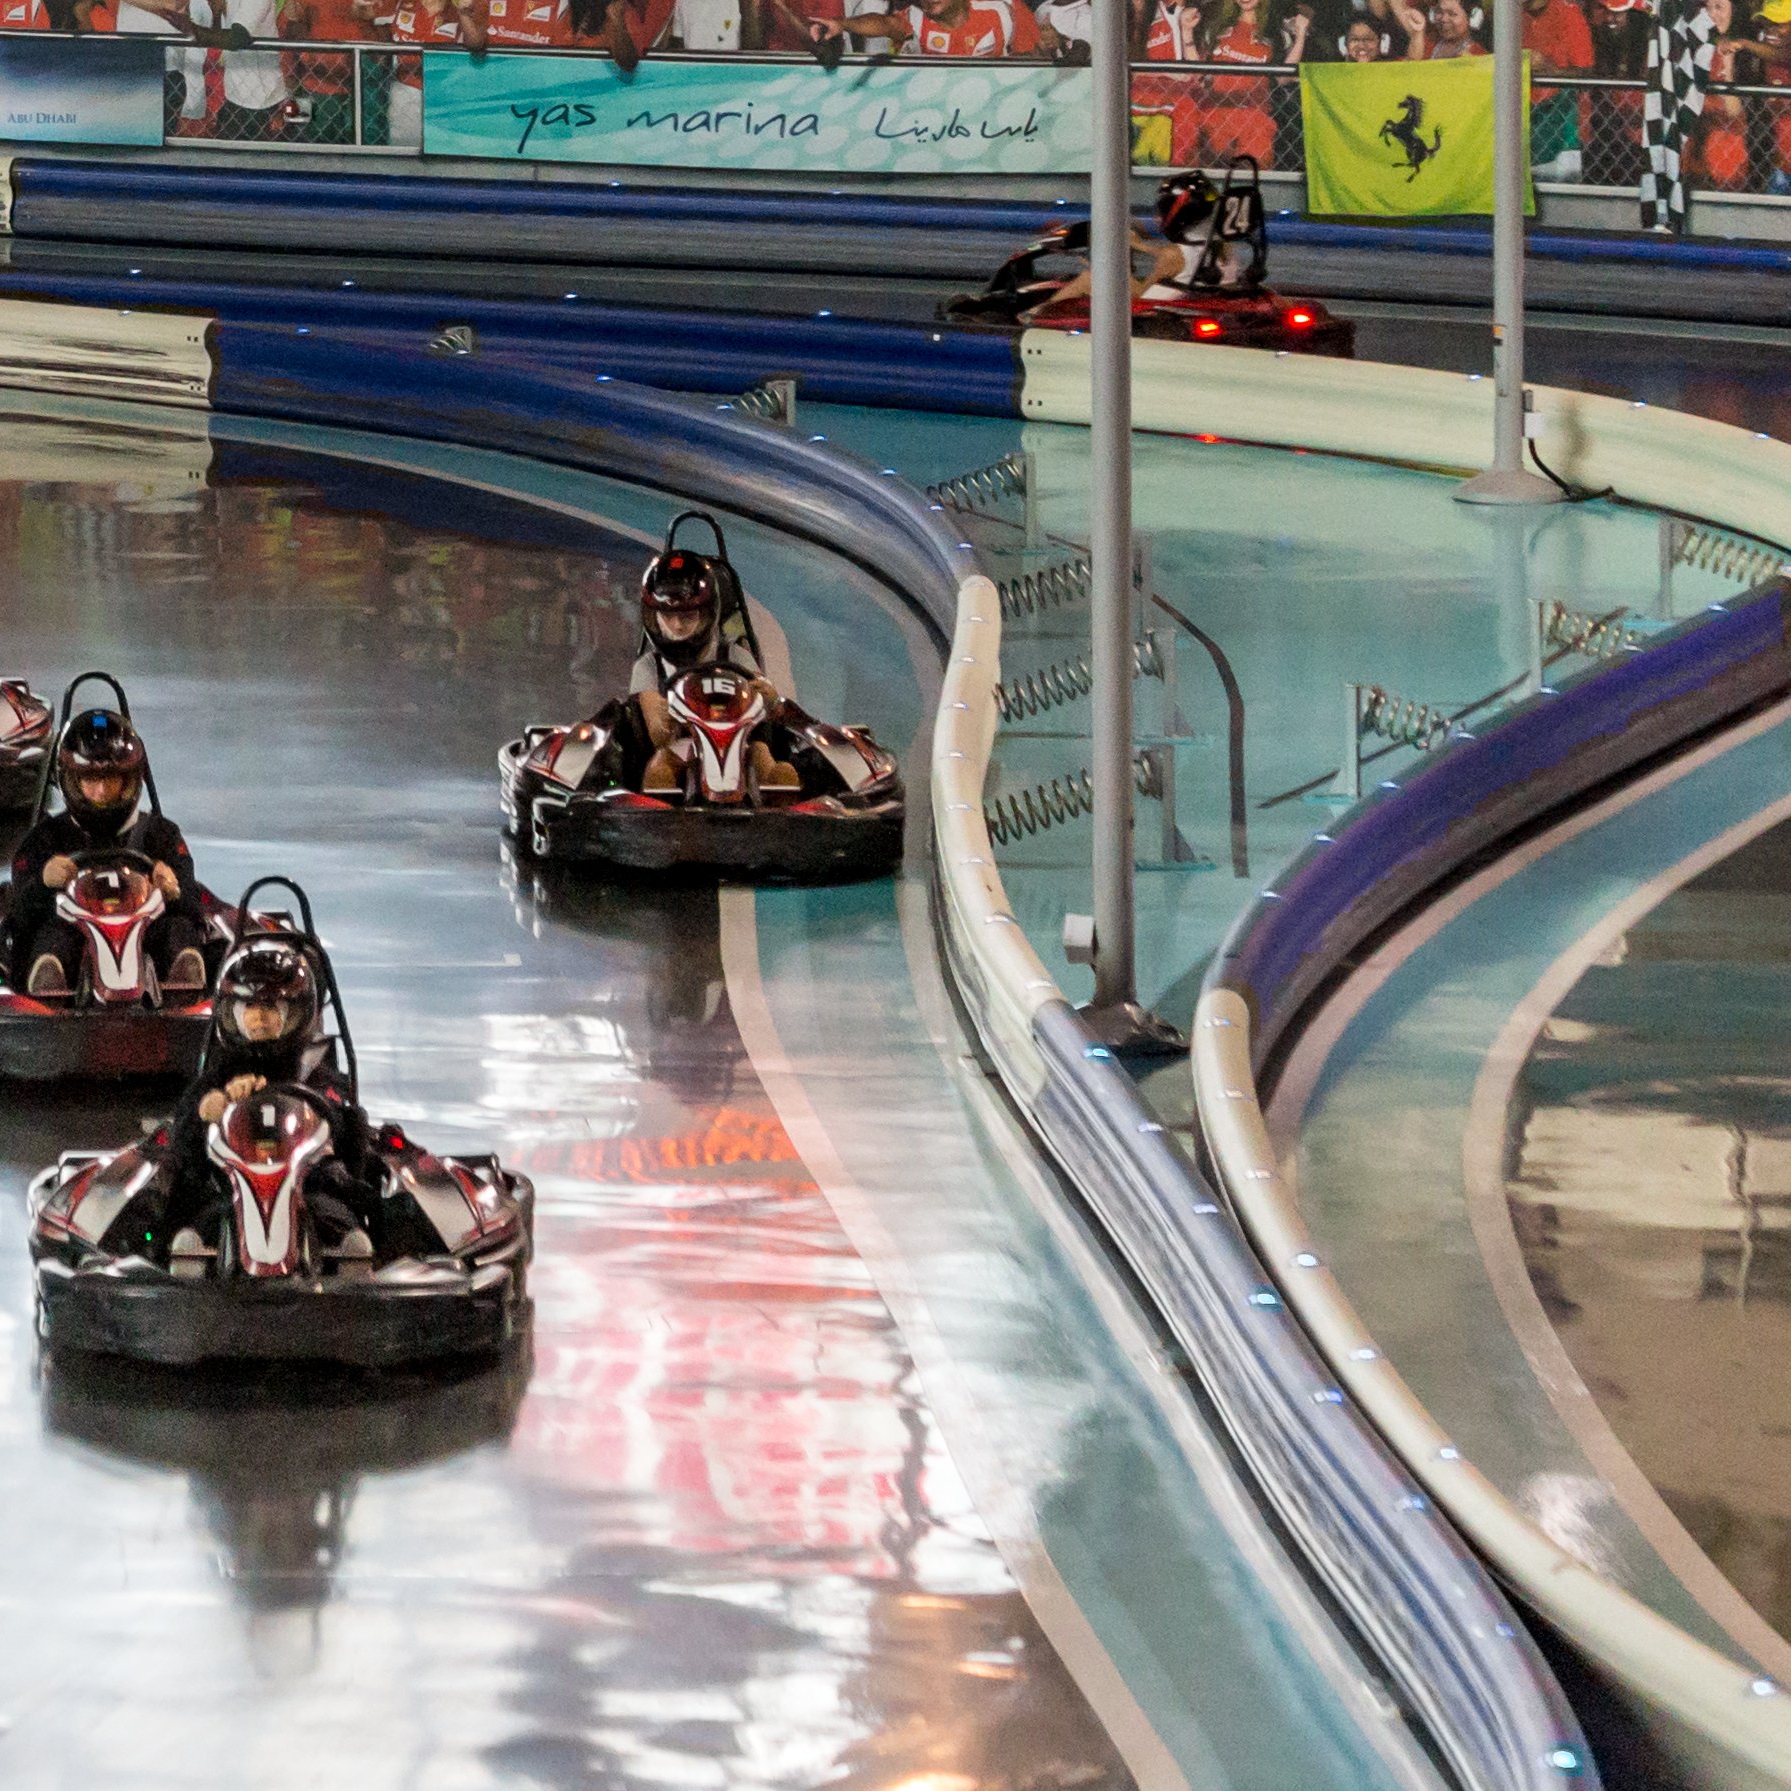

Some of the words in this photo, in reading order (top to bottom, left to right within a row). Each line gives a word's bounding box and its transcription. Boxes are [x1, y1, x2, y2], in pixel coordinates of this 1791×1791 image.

[7, 112, 33, 125] ABU
[36, 112, 77, 125] DHABI
[509, 102, 597, 154] yas
[626, 101, 820, 138] marina
[1223, 196, 1251, 235] 24
